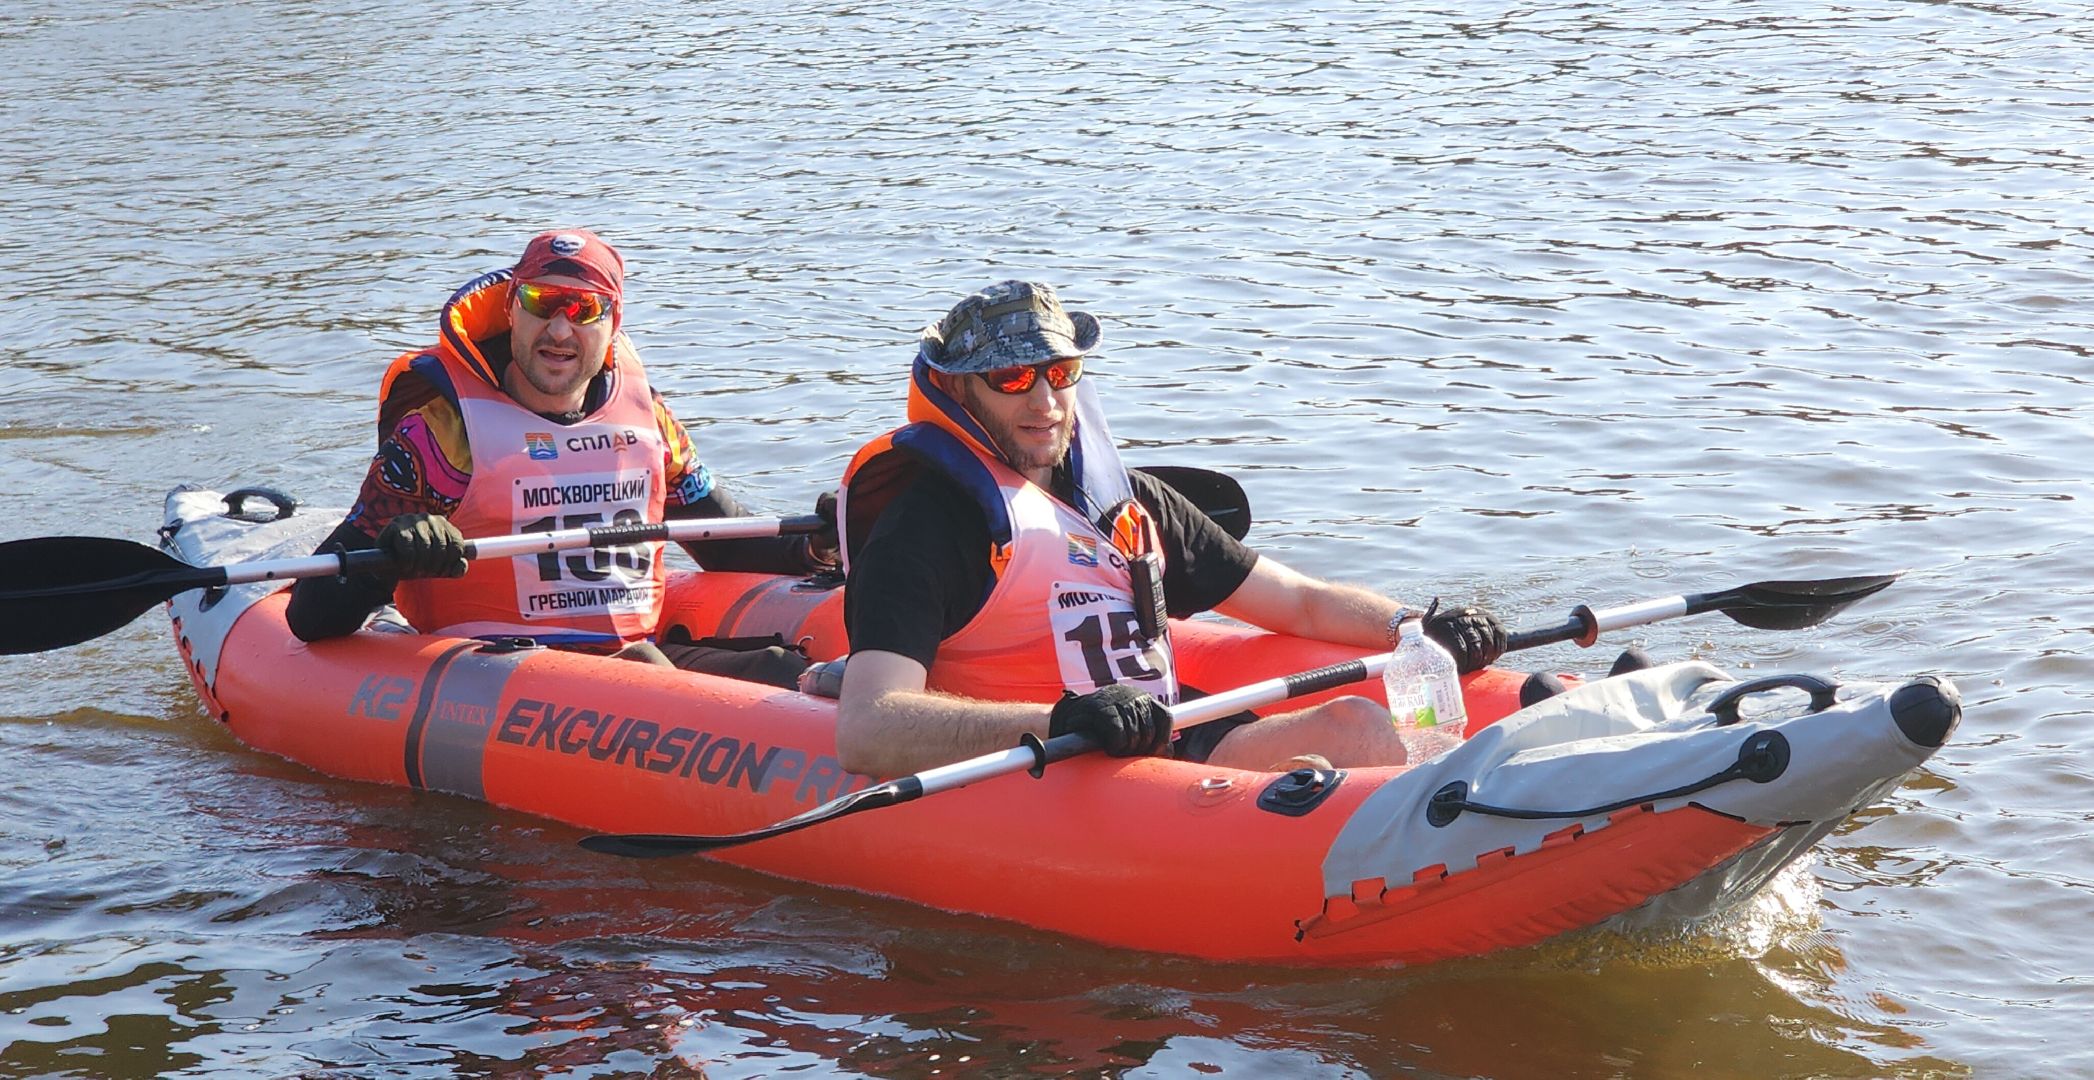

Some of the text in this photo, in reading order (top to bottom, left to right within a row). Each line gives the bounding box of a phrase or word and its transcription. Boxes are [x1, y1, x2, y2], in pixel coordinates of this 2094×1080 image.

[566, 430, 638, 452] СПЛАВ
[523, 475, 645, 508] МОСКВОРЕЦКИЙ
[1064, 611, 1170, 687] 15
[348, 672, 415, 720] K2
[439, 701, 488, 726] INTEX
